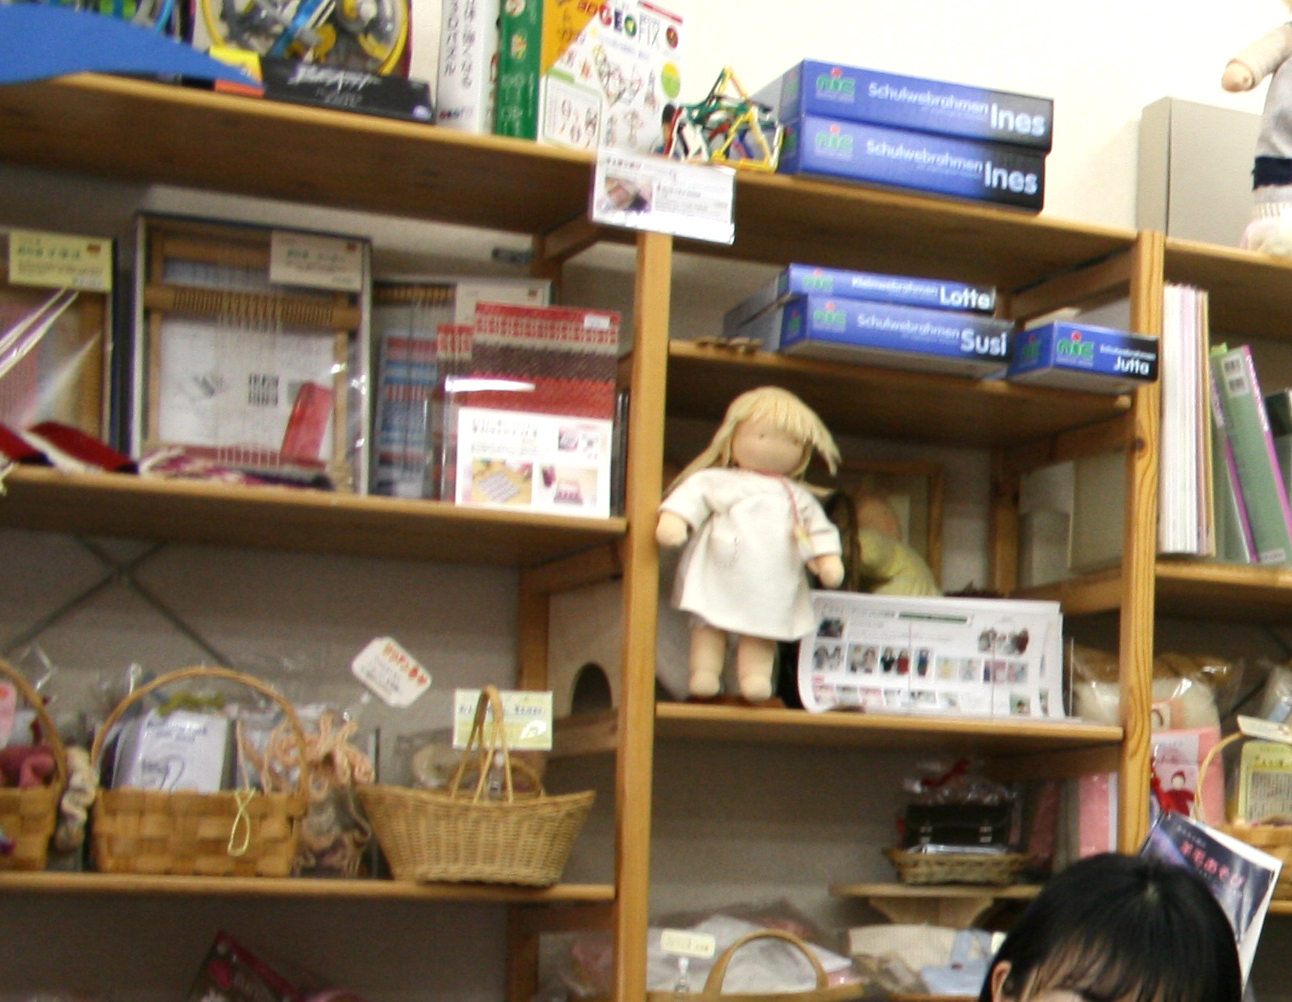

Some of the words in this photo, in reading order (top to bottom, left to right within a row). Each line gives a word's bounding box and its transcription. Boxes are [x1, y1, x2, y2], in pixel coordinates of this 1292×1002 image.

[868, 82, 989, 116] Schulwebrahmen
[990, 102, 1047, 137] Ines
[866, 140, 983, 173] Schulwebrahmen
[984, 160, 1039, 195] Ines
[939, 286, 992, 310] Lotta
[960, 328, 1008, 357] Susi
[1113, 356, 1150, 376] Jutta
